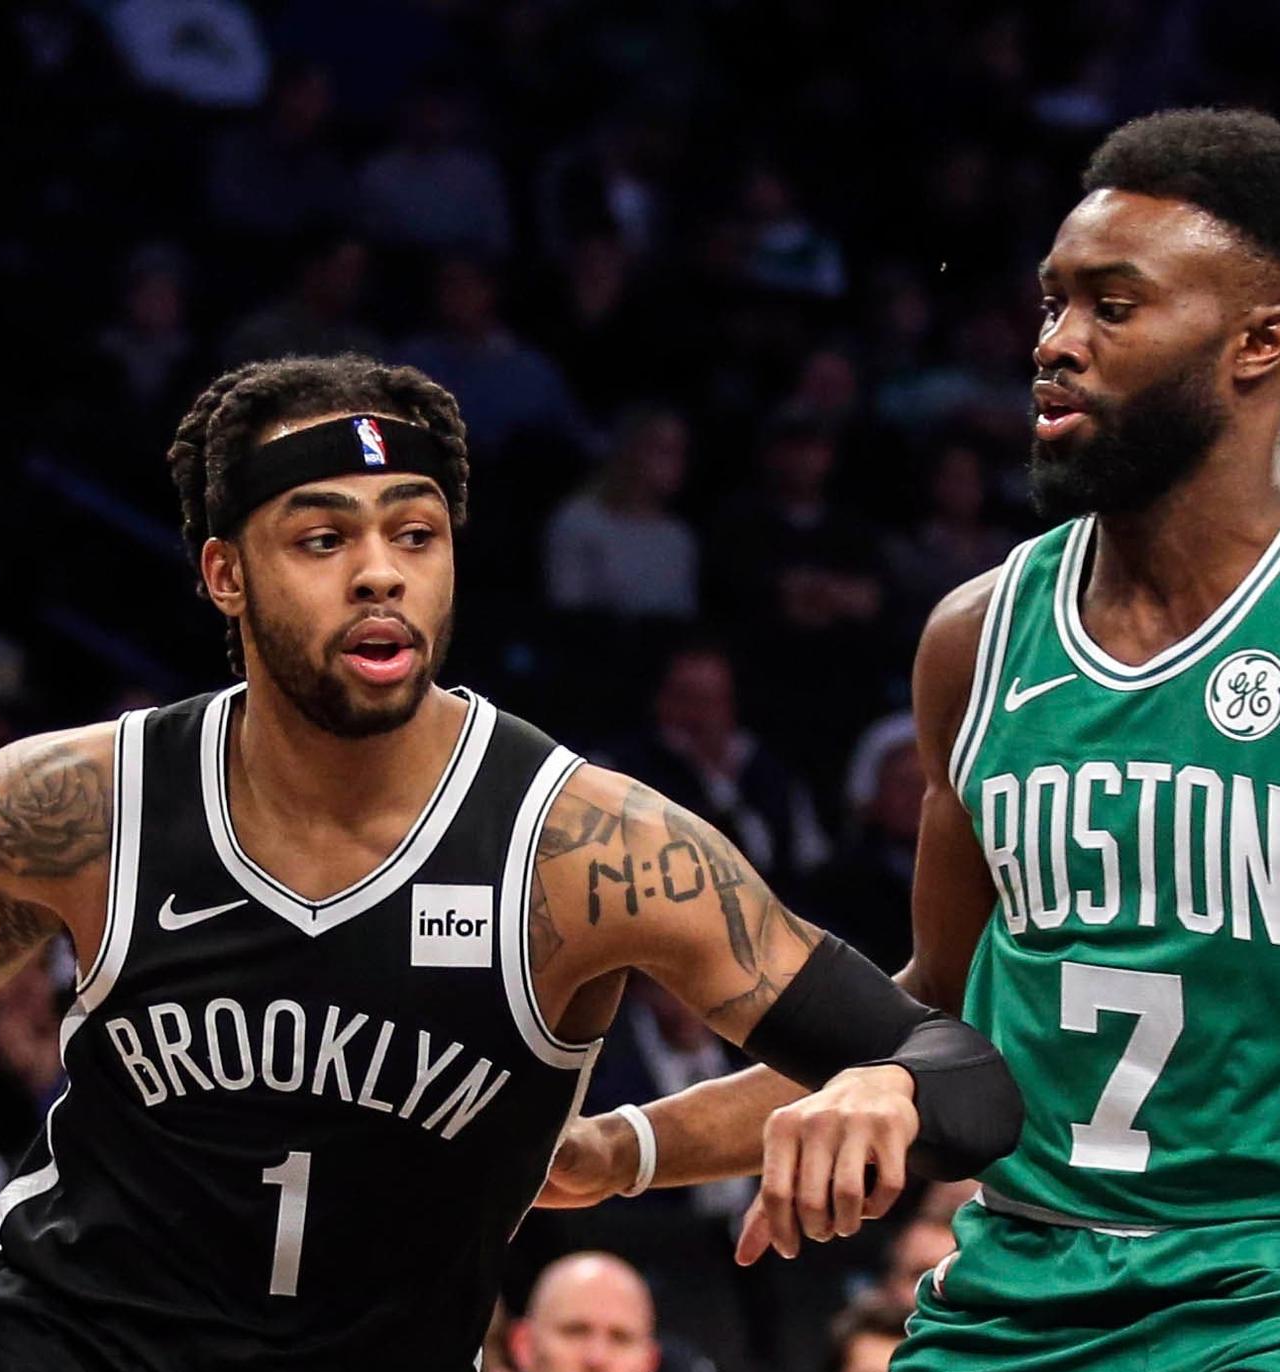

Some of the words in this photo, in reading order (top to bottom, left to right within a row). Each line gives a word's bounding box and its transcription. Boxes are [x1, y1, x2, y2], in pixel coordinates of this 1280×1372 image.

[1227, 669, 1272, 719] GE
[419, 909, 488, 938] infor
[105, 997, 512, 1140] BROOKLYN
[1060, 961, 1184, 1173] 7
[262, 1151, 312, 1296] 1
